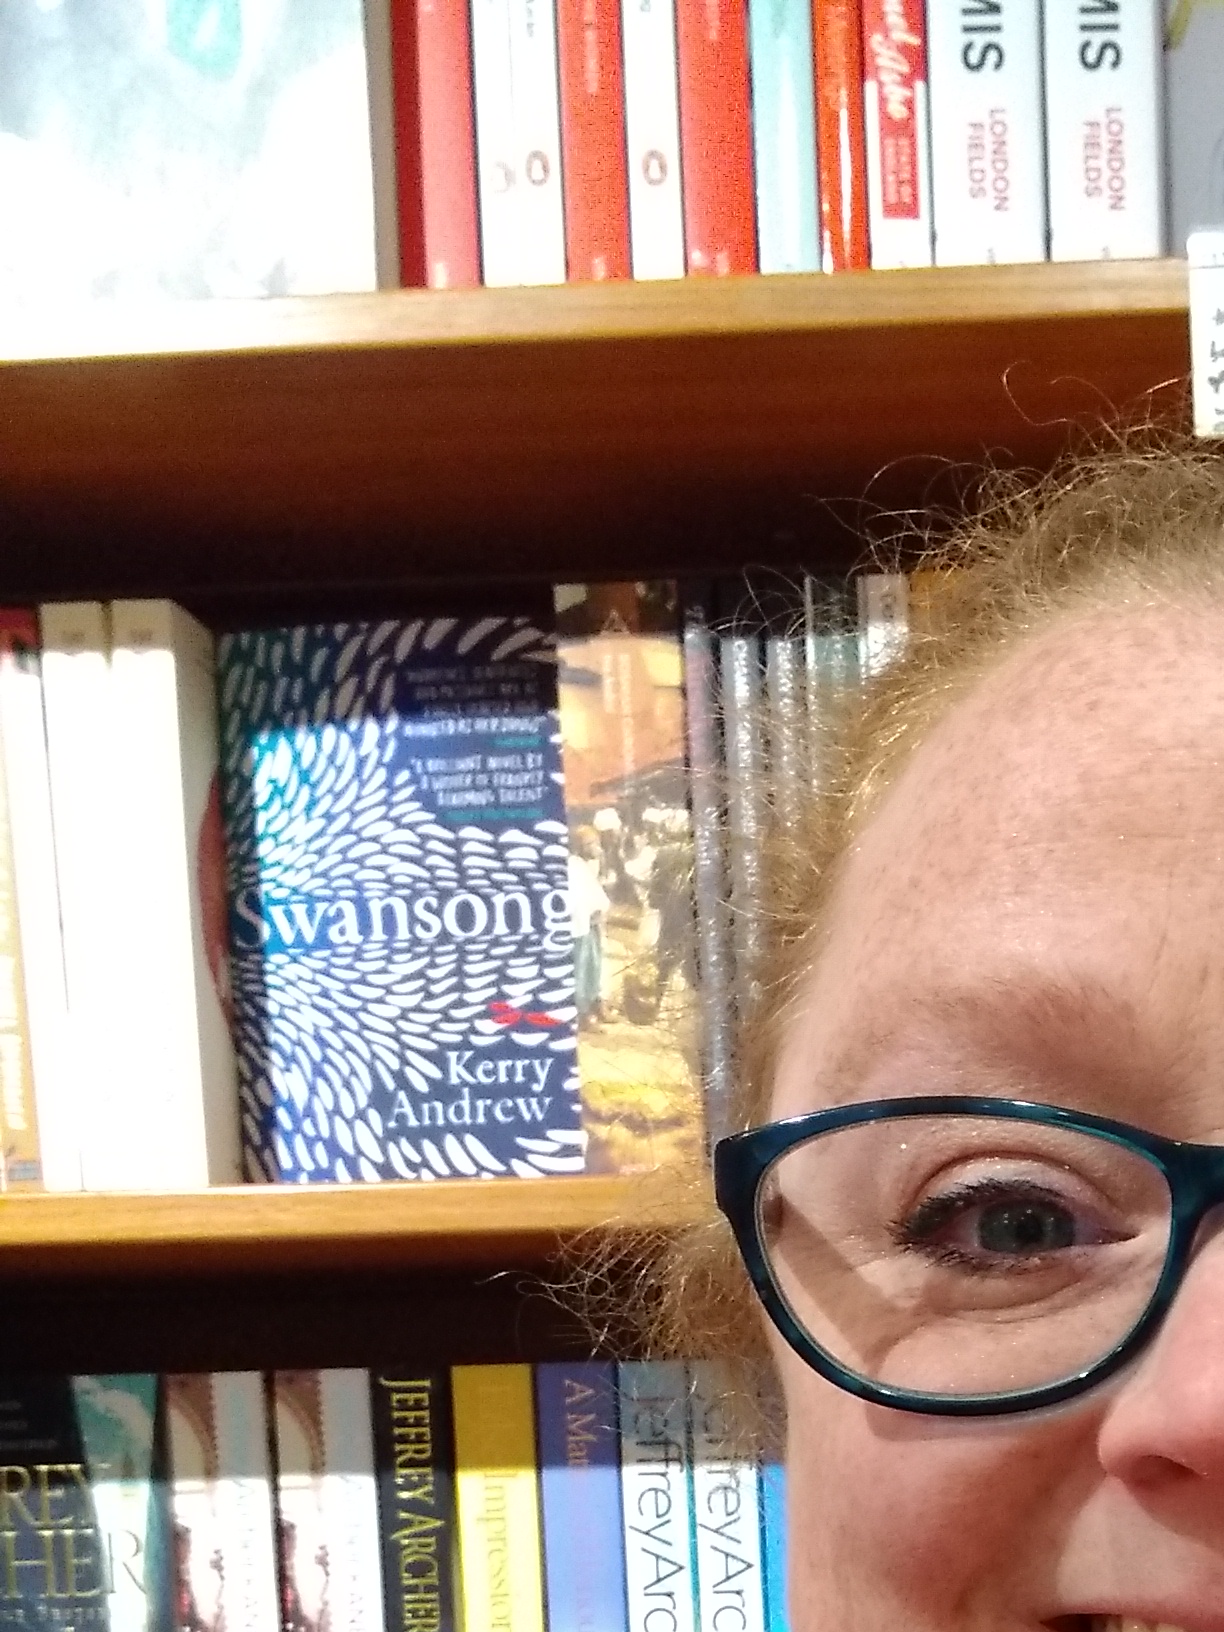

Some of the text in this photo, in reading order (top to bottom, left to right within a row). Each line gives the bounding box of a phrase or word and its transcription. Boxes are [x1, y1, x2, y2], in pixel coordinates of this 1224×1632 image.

[969, 122, 986, 200] FIELDS
[990, 107, 1009, 212] LONDON
[1083, 121, 1101, 199] FIELDS
[1107, 106, 1126, 211] LONDON
[235, 885, 577, 955] Swansong
[387, 1088, 553, 1130] Andrew
[447, 1049, 555, 1092] Kerry
[382, 1378, 432, 1503] JEFFREY
